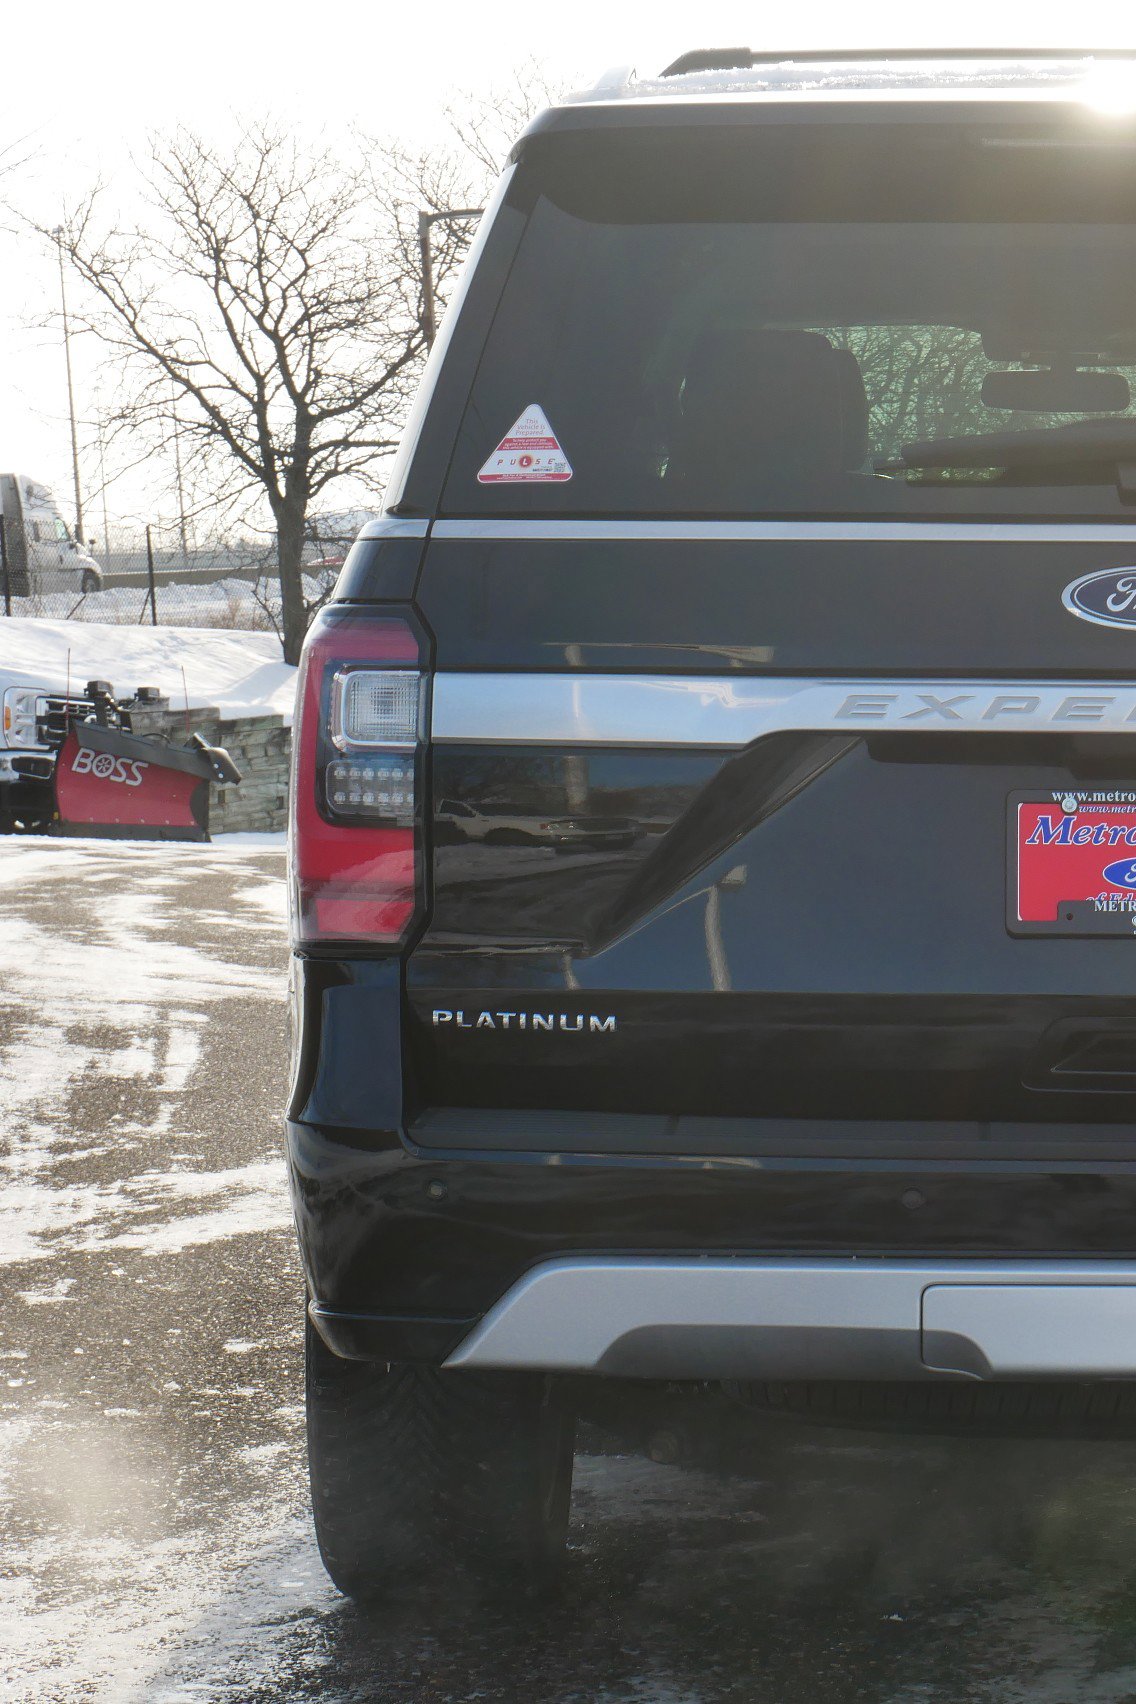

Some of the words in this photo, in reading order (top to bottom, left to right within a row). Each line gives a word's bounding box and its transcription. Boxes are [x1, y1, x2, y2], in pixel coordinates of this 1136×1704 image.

[497, 457, 555, 467] PULSE
[71, 747, 149, 787] BOSS
[432, 1008, 617, 1033] PLATINUM
